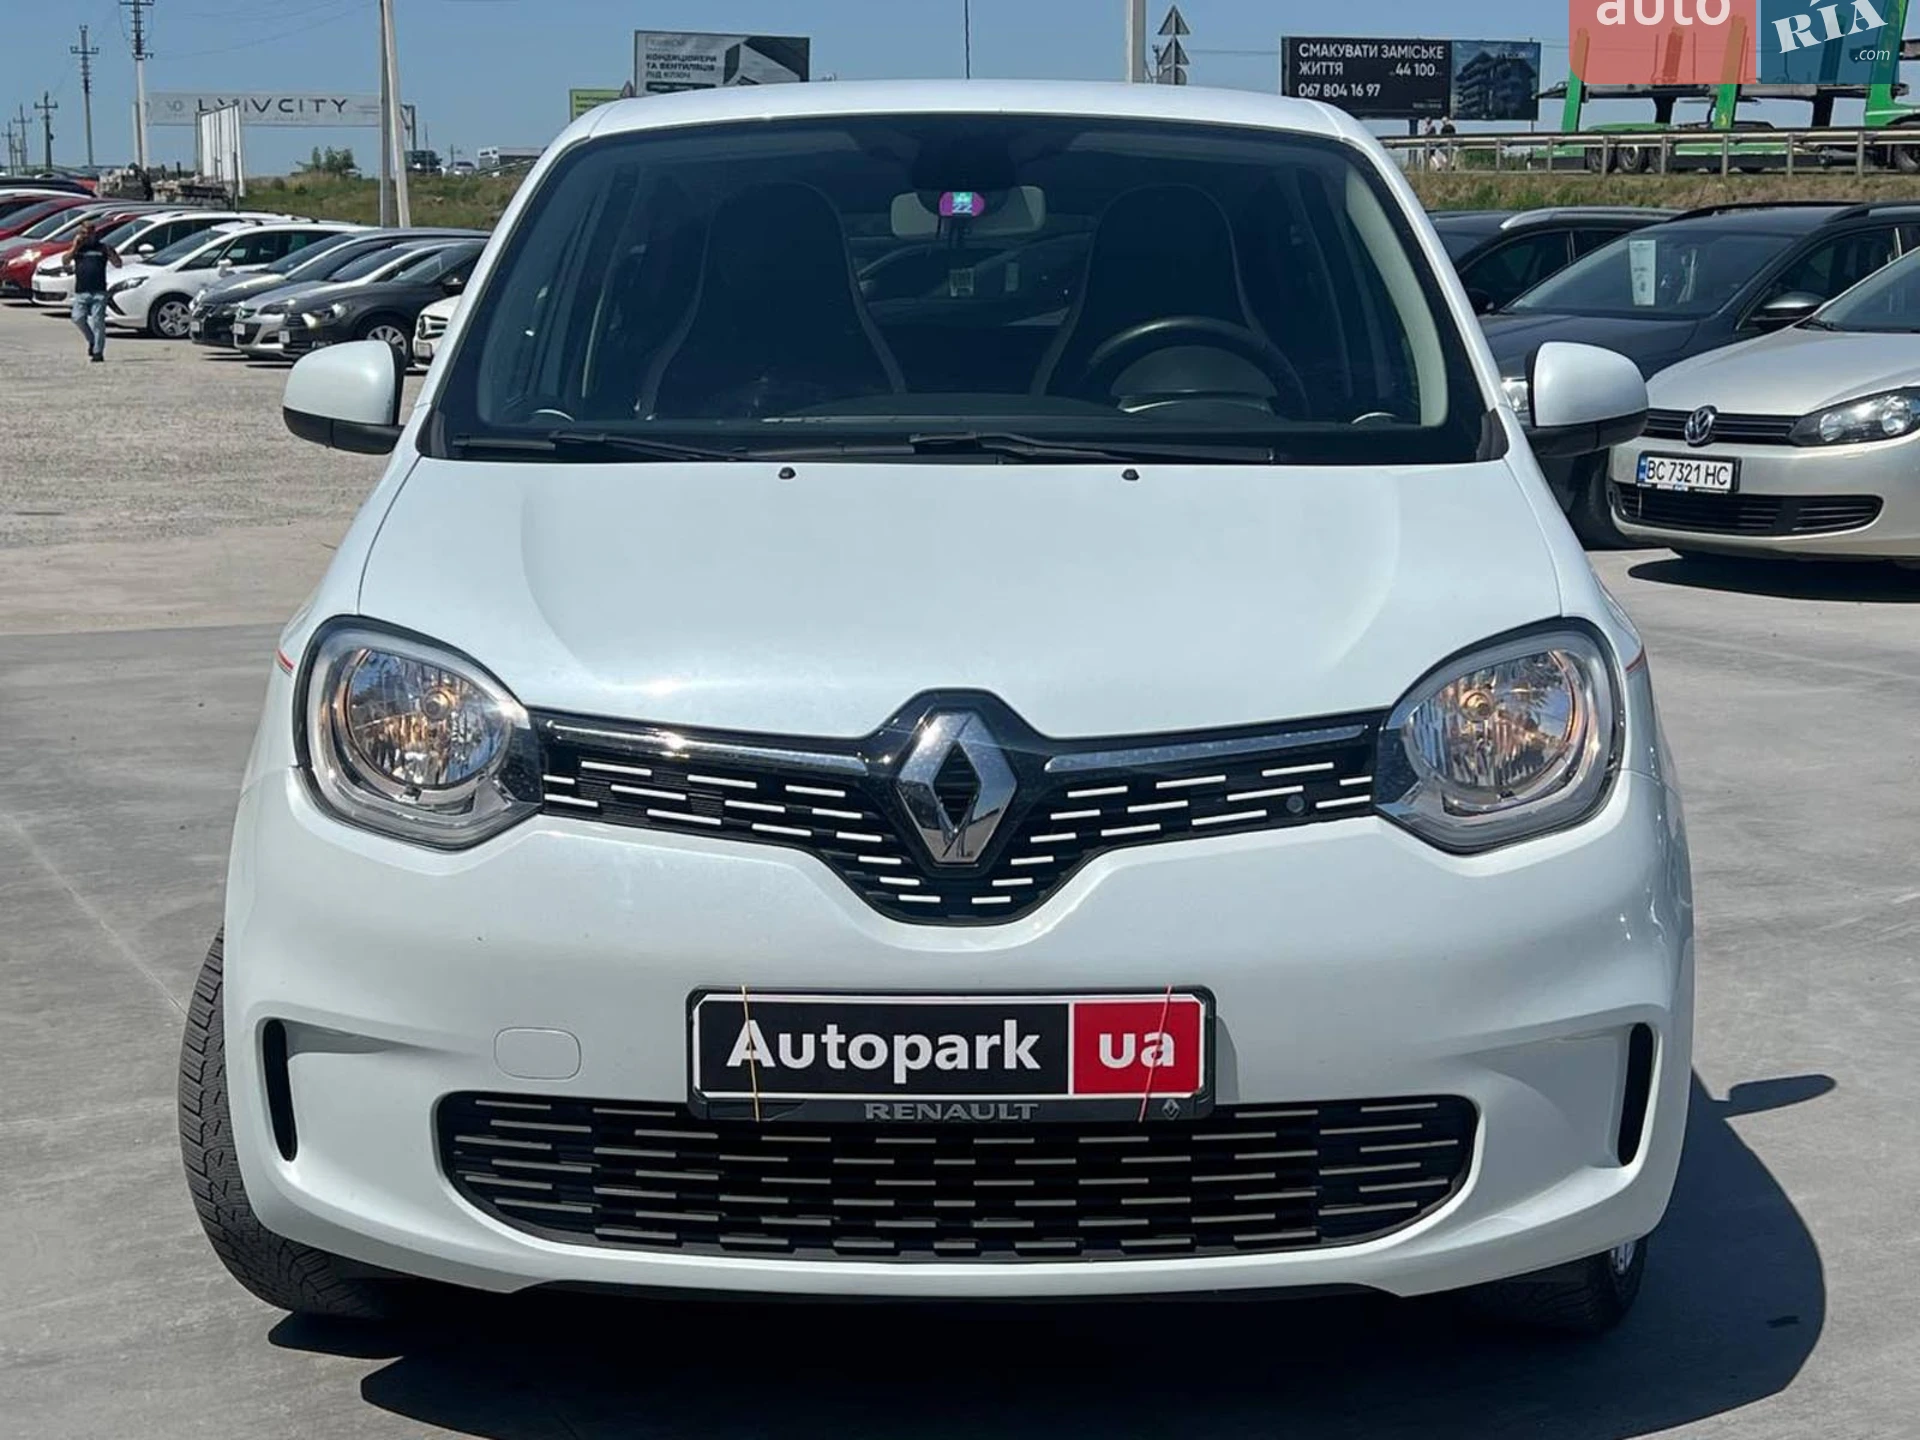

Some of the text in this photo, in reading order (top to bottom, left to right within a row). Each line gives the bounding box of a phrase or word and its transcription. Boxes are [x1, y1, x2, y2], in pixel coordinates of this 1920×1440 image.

[1298, 43, 1445, 60] СМАКУВАТИ ЗАМІСЬКЕ
[1298, 61, 1344, 76] ЖИТТЯ
[1395, 62, 1435, 76] 44 100
[1298, 83, 1381, 97] 067 804 16 97
[1646, 460, 1729, 486] BC 7321 HC
[726, 1019, 1175, 1085] Autopark ua
[864, 1102, 1040, 1121] RENAULT
